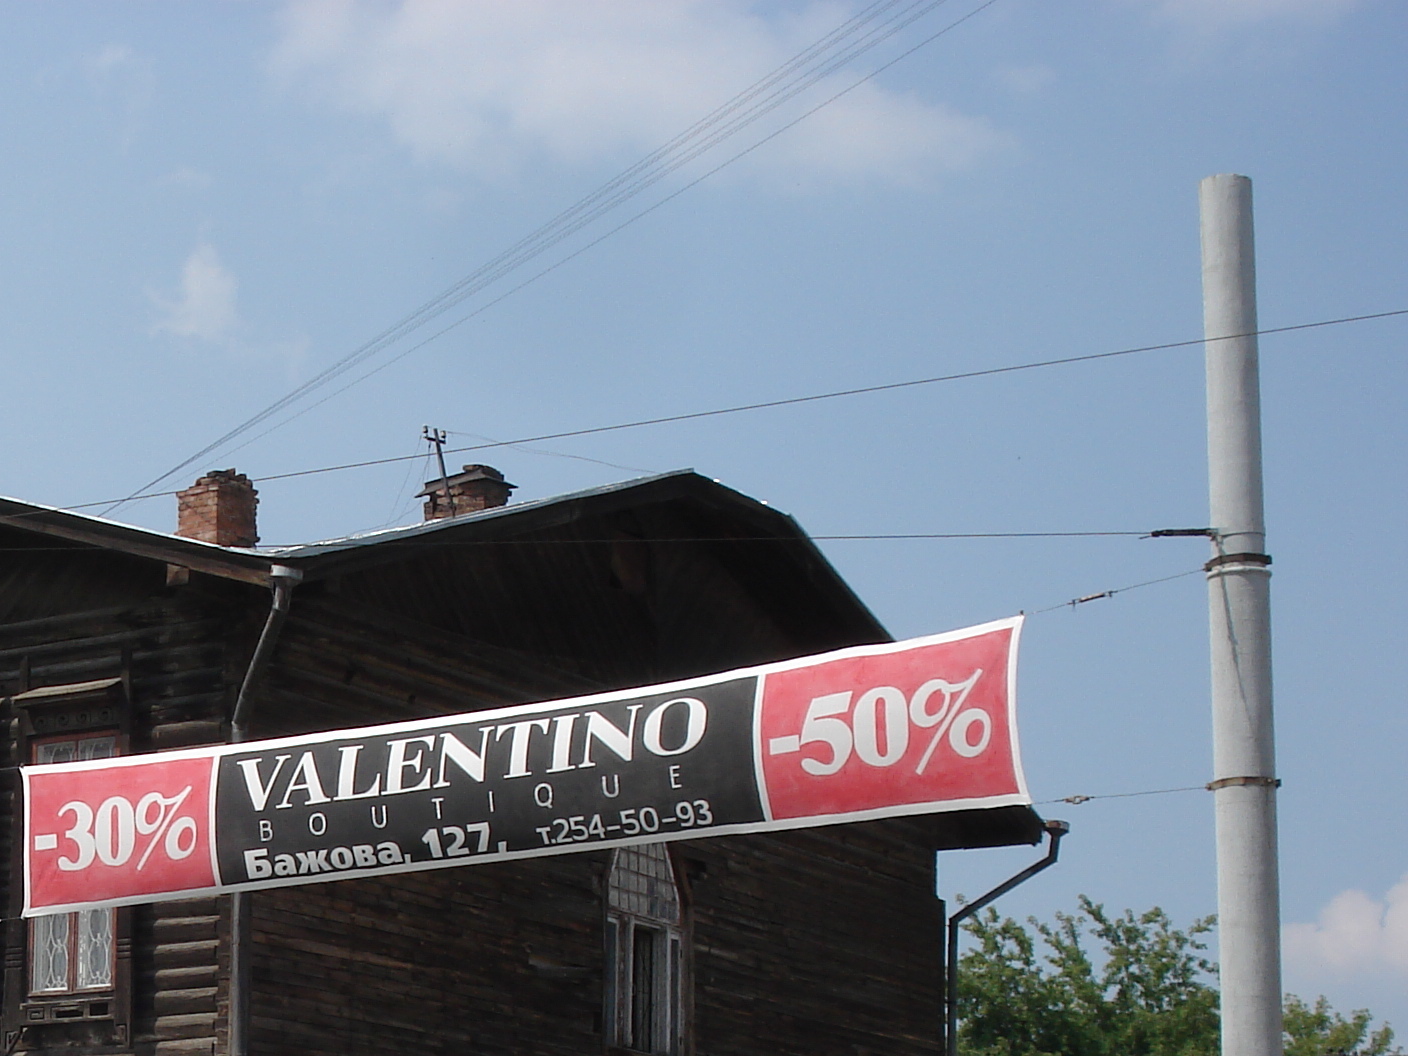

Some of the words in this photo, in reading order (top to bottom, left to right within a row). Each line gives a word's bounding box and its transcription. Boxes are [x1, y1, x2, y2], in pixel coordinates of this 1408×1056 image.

[237, 697, 709, 812] VALENTINO
[769, 668, 992, 776] -50%
[34, 785, 198, 873] -30%
[244, 840, 412, 880] Бажова,
[421, 822, 507, 860] 127,
[536, 799, 714, 846] т.254-50-93
[259, 764, 681, 842] BOUTIQUE
